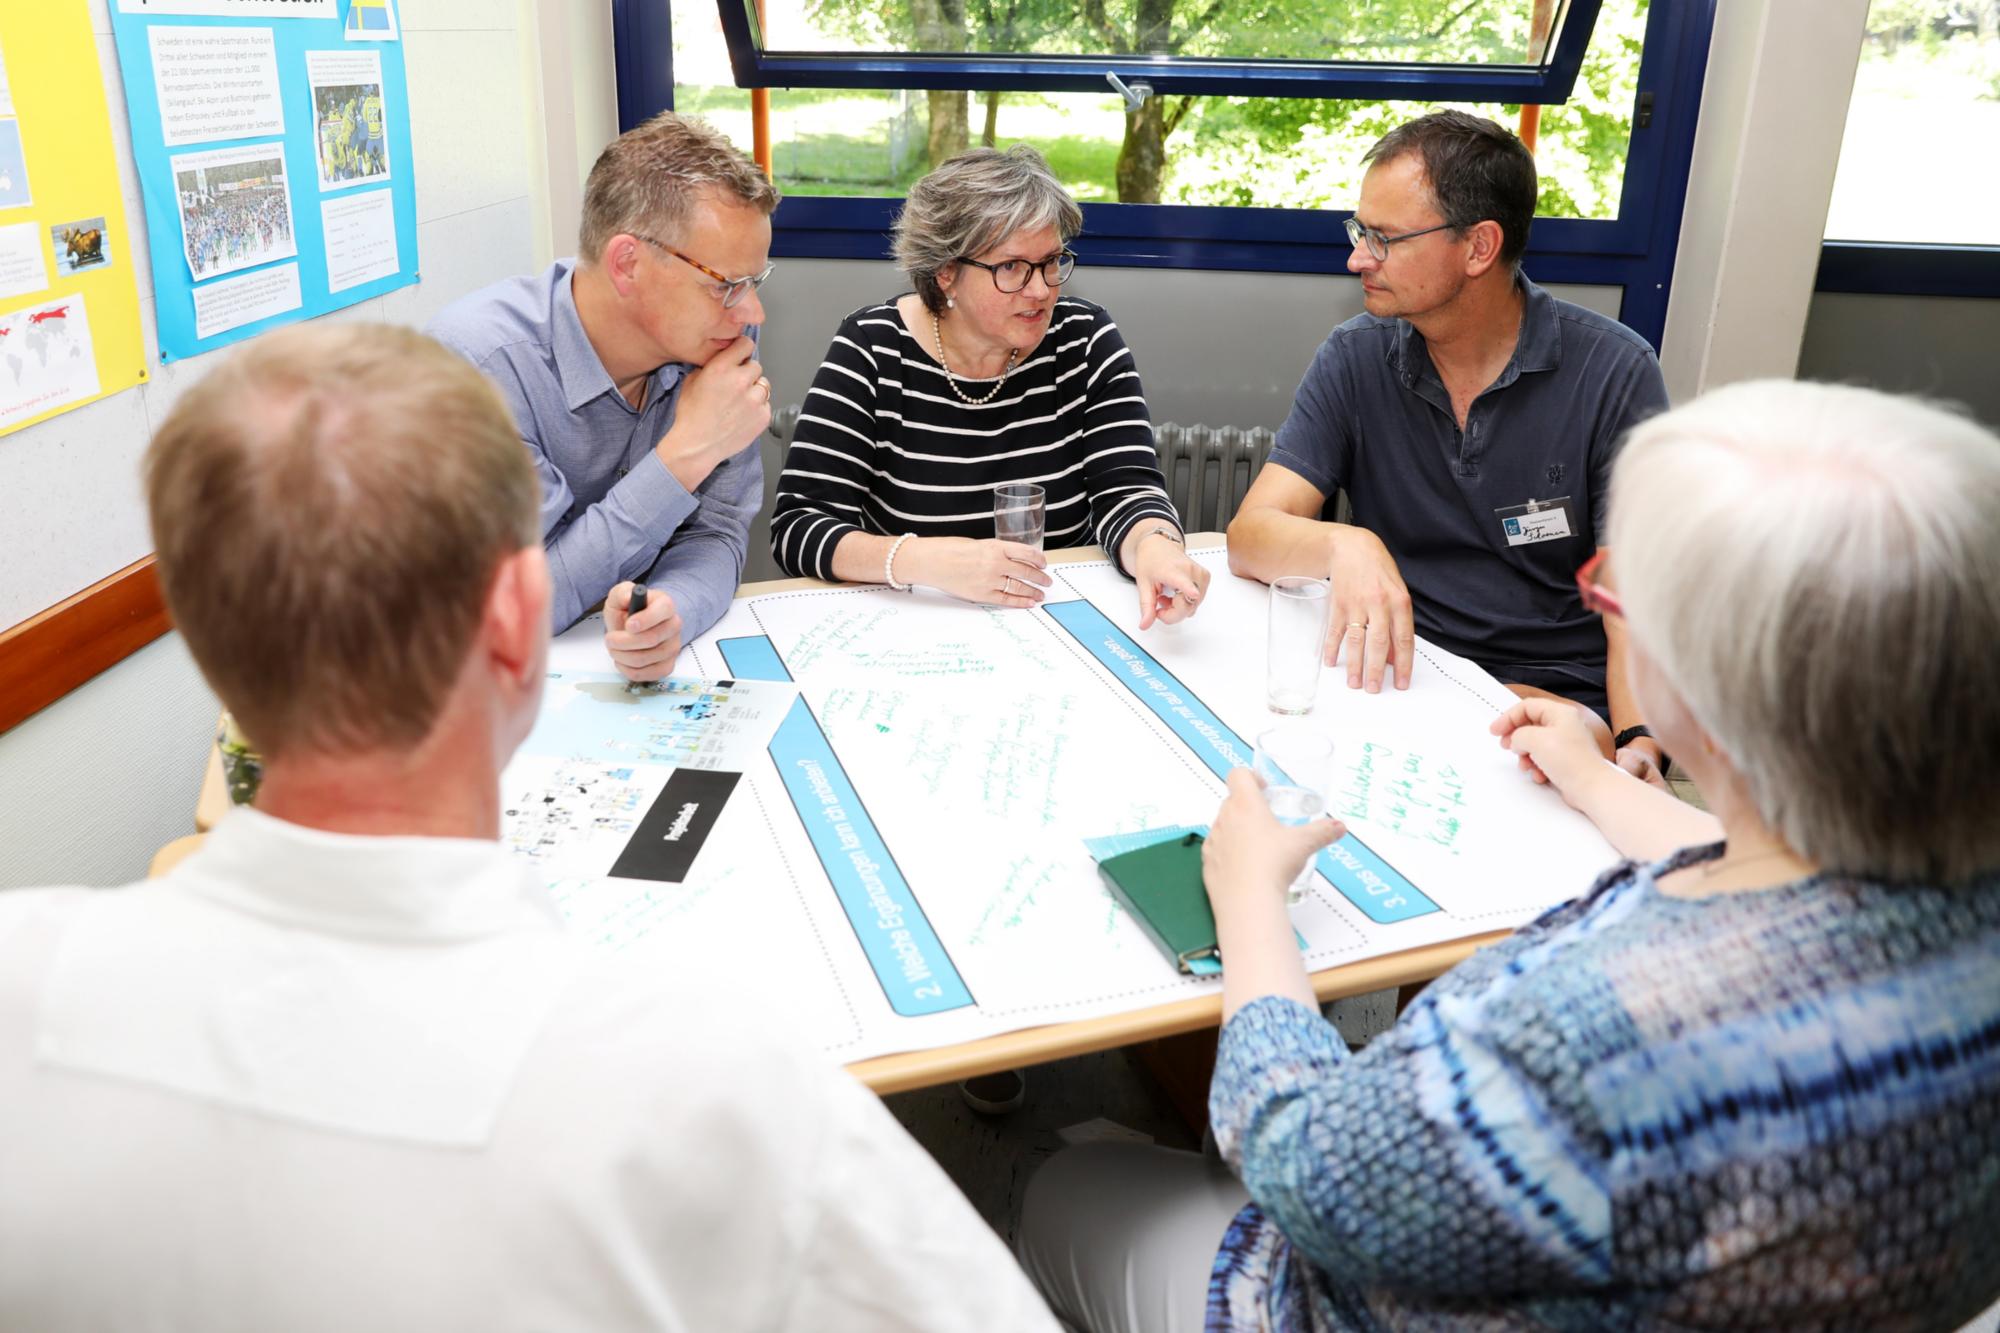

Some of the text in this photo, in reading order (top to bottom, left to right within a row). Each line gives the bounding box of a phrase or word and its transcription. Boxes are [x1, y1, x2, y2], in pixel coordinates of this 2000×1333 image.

[1126, 659, 1151, 679] Weg
[1145, 676, 1169, 692] den
[1154, 690, 1183, 706] auf
[1171, 704, 1198, 720] mit
[796, 758, 840, 805] anbieten?
[821, 803, 848, 823] ich
[834, 822, 863, 851] kann
[848, 849, 906, 930] Ergänzungen
[1356, 869, 1392, 896] Das
[1383, 892, 1408, 909] 3.
[889, 928, 933, 984] Welche
